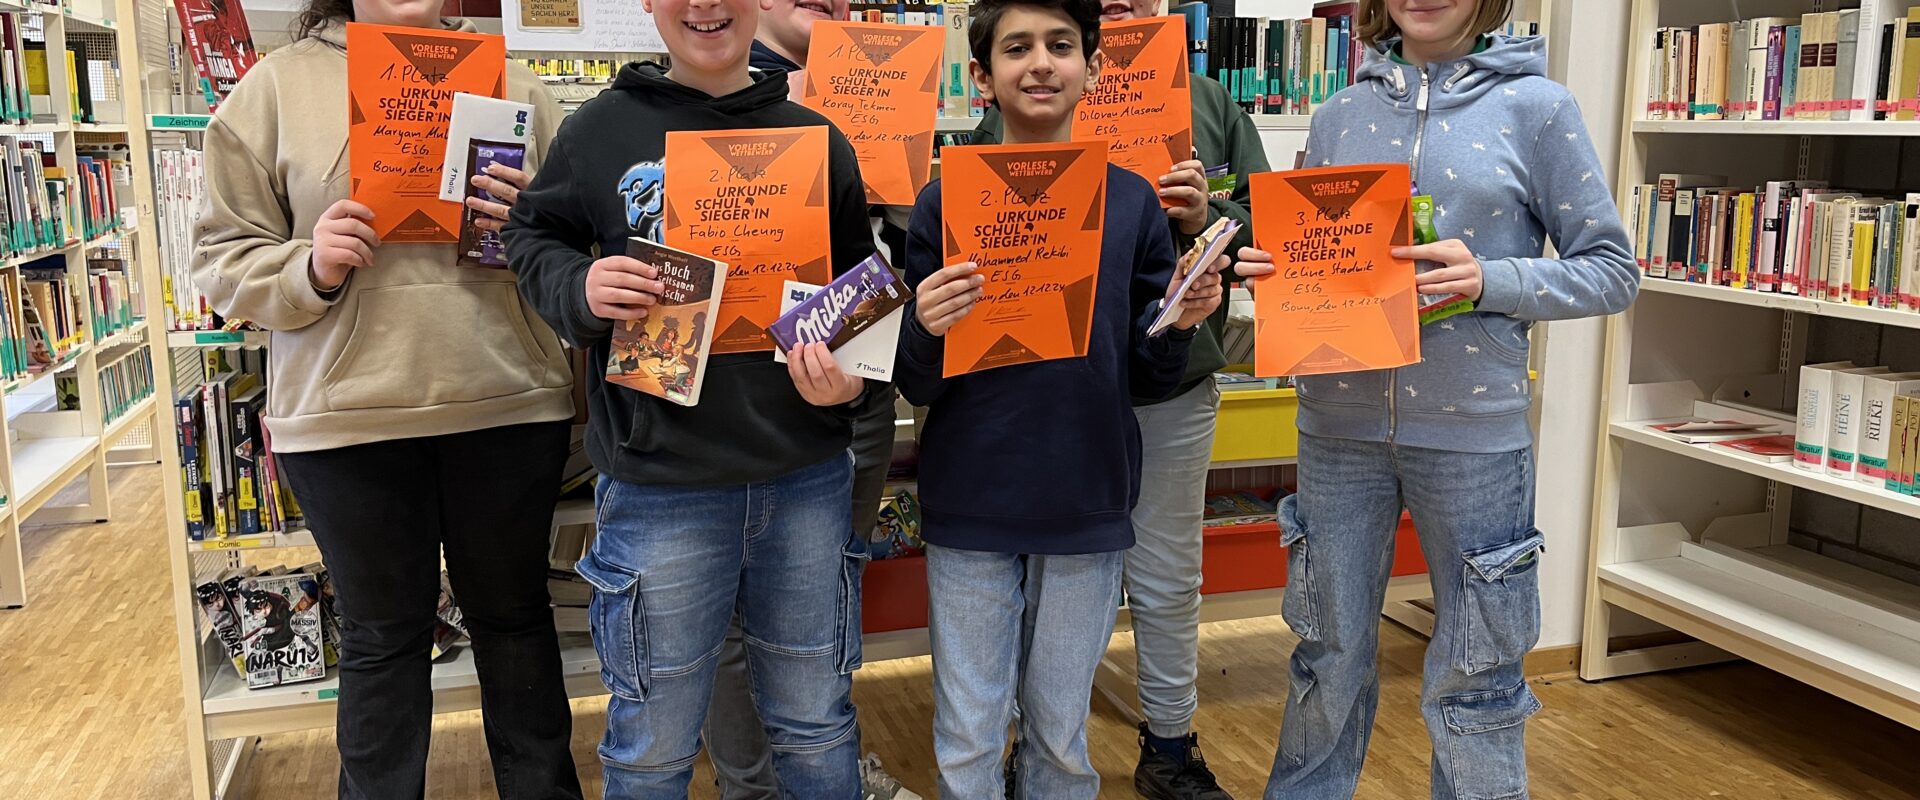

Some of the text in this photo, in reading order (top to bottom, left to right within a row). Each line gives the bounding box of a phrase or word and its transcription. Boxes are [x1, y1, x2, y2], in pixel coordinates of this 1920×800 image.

[862, 33, 896, 42] VORLESE
[1103, 33, 1136, 42] VORLESE
[410, 43, 450, 54] VORLESE
[1105, 40, 1141, 48] WETTBEWERB
[828, 44, 844, 58] 1.
[206, 56, 237, 78] MANGA
[380, 64, 448, 82] 1. Platz
[849, 68, 908, 80] URKUNDE
[1098, 70, 1156, 85] URKUNDE
[829, 76, 868, 86] SCHUL
[401, 87, 470, 100] URKUN
[378, 98, 425, 110] SCHUL
[822, 97, 896, 116] Koray Tekmen
[851, 113, 879, 125] ESG
[1080, 110, 1118, 121] Dilovan
[373, 125, 421, 145] Maryam
[1095, 125, 1118, 135] ESG
[402, 143, 430, 155] ESG
[728, 142, 768, 150] VORLESE
[1110, 140, 1129, 150] den
[410, 162, 433, 173] den
[1007, 160, 1047, 171] VORLESE
[710, 164, 766, 182] 2. Platz
[1009, 169, 1053, 177] WETTBEWERB
[448, 174, 457, 194] Thalia
[1311, 180, 1350, 191] VORLESE
[716, 184, 788, 198] URKUNDE
[980, 185, 1051, 206] 2. Platz
[1313, 188, 1357, 196] WETTBEWERB
[695, 198, 741, 210] SCHUL
[997, 208, 1066, 223] URKUNDE
[1295, 207, 1351, 226] 3. Platz
[690, 225, 784, 242] Fabio Cheung
[974, 224, 1020, 237] SCHUL
[1304, 223, 1373, 239] URKUNDE
[712, 245, 741, 257] ESG
[1283, 239, 1328, 252] SCHUL
[664, 262, 690, 280] Buch
[729, 262, 800, 277] den 12.12.24
[1284, 267, 1325, 279] Celine
[991, 270, 1021, 282] ESG
[1294, 283, 1322, 294] ESG
[975, 294, 997, 304] onn,
[999, 288, 1020, 300] den
[1316, 299, 1337, 310] den
[795, 283, 858, 345] Milka
[863, 364, 886, 374] Thalia
[1838, 394, 1851, 436] HEINE
[1869, 399, 1883, 442] RILKE
[1895, 408, 1904, 426] POE
[1910, 411, 1919, 430] POE
